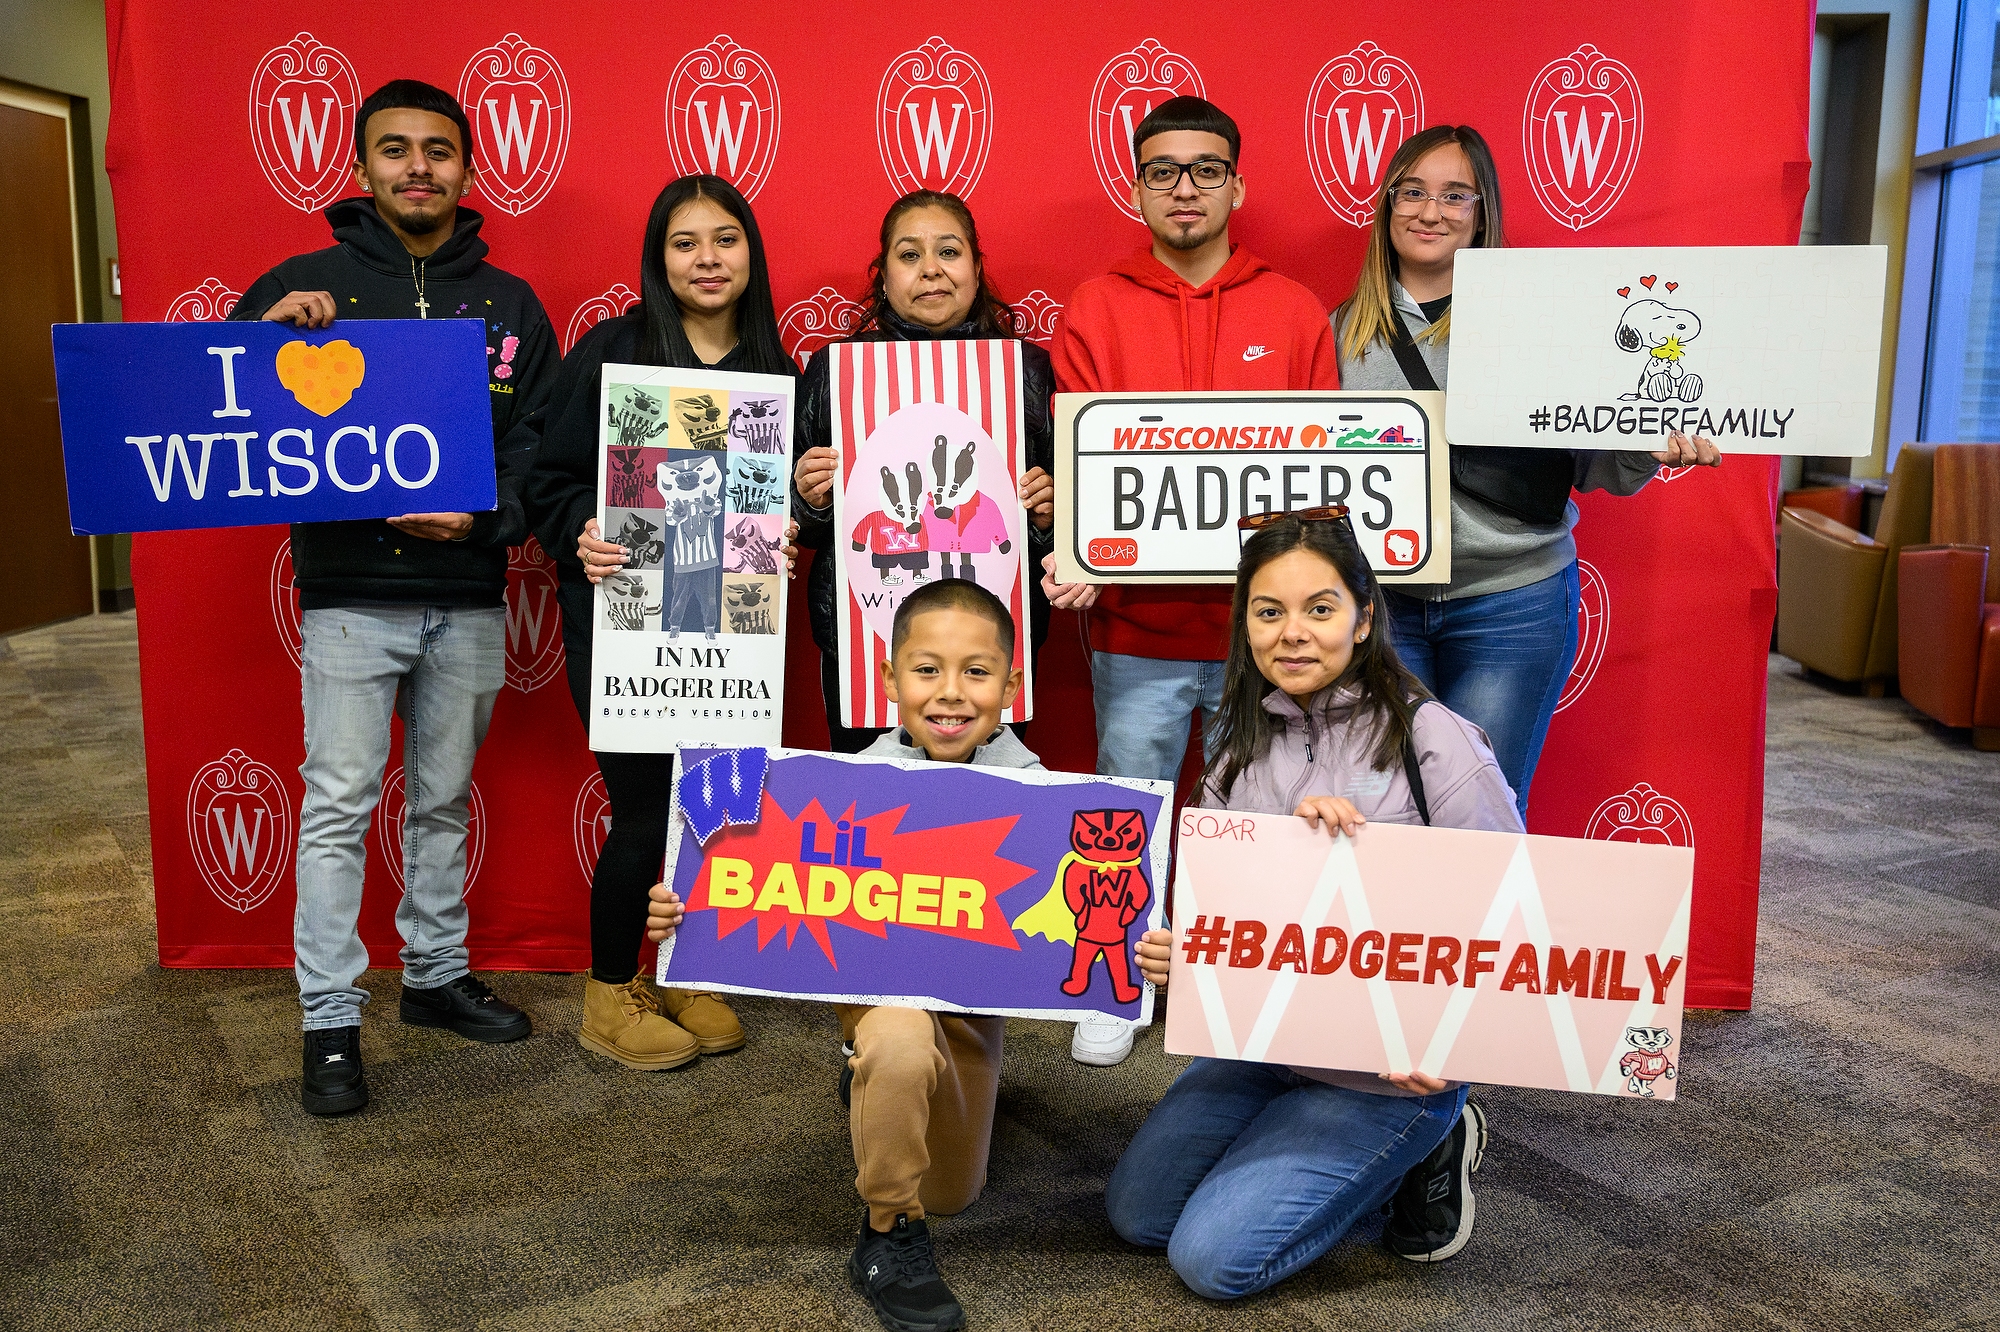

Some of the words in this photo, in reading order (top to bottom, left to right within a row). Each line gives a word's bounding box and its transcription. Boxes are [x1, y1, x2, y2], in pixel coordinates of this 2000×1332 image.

[277, 91, 335, 174] W
[485, 92, 544, 176] W
[694, 95, 753, 179] W
[905, 97, 966, 180] W
[1335, 101, 1396, 186] W
[1553, 103, 1615, 189] W
[206, 345, 252, 418] I
[1246, 345, 1266, 356] NIKE
[1112, 425, 1294, 450] WISCONSIN
[1528, 404, 1795, 439] #BADGERFAMILY
[125, 423, 441, 503] WISCO
[1112, 464, 1393, 532] BADGERS
[1089, 543, 1137, 561] SOAR
[603, 675, 715, 699] BADGER
[720, 678, 772, 700] ERA
[654, 646, 684, 667] IN
[689, 647, 731, 669] MY
[691, 707, 772, 719] VERSION
[212, 802, 266, 876] W
[1180, 813, 1256, 843] SOAR
[707, 856, 988, 930] BADGER
[1089, 868, 1132, 909] W
[1180, 913, 1684, 1006] #BADGERFAMILY
